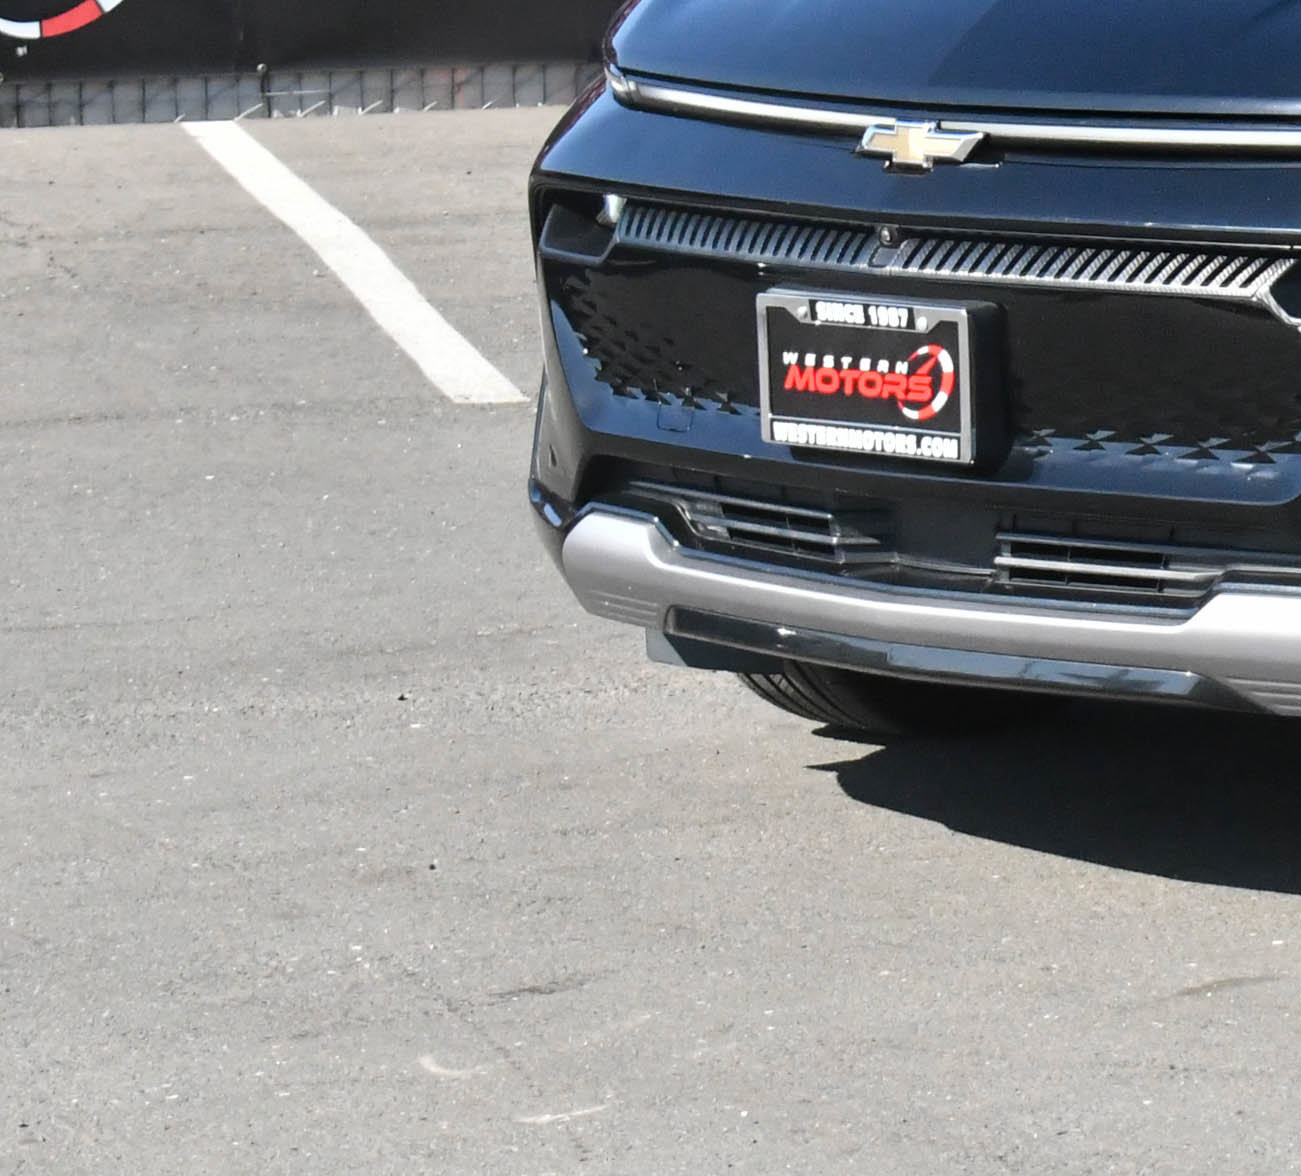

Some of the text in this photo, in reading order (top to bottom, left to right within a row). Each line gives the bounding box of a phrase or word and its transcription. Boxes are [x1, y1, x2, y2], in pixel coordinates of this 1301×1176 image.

[816, 301, 866, 324] SINCE
[782, 351, 909, 375] WESTERN
[784, 364, 933, 401] MOTORS
[773, 422, 958, 458] WESTERNMOTORS.COM
